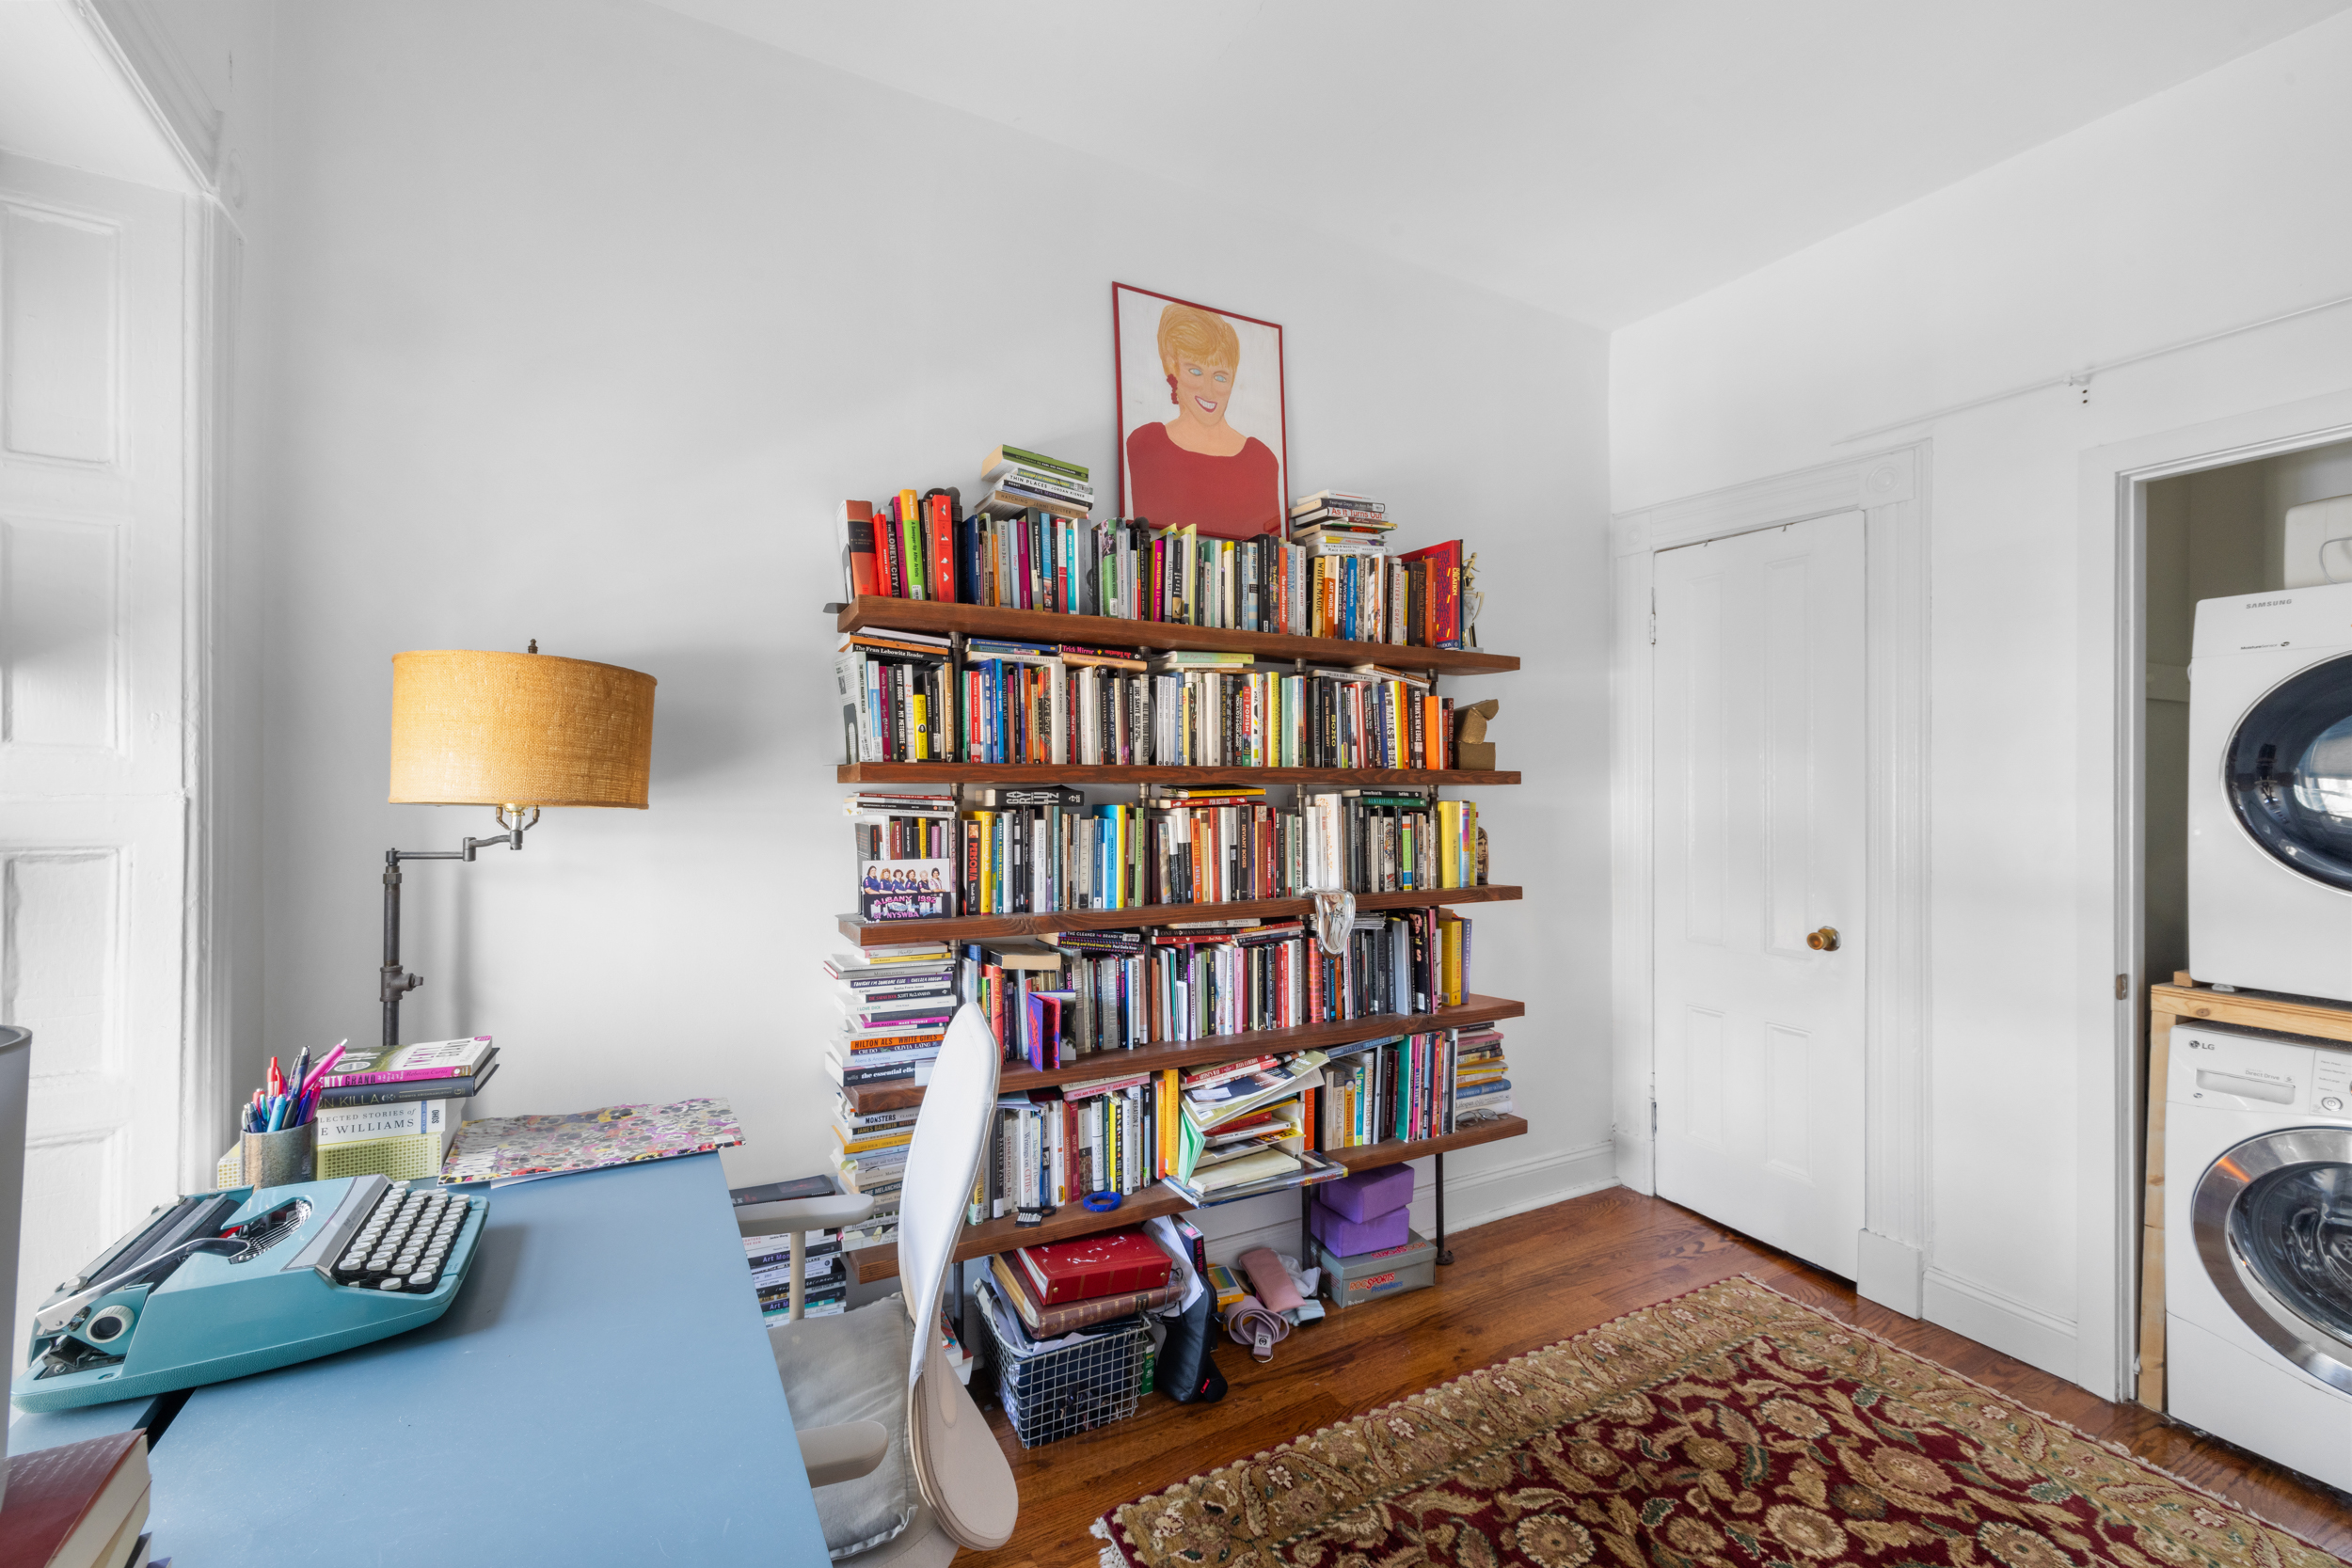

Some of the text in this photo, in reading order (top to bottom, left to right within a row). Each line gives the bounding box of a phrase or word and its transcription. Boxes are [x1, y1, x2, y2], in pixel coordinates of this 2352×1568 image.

[1026, 479, 1047, 488] PLACES
[1001, 494, 1028, 504] HATCHING
[1051, 505, 1071, 514] QUILTER
[888, 534, 897, 564] LONELY
[2246, 599, 2292, 609] SAMSUNG
[1449, 701, 1453, 710] ON
[969, 843, 977, 881] PERSON/A
[875, 896, 912, 906] ALBANY
[319, 1074, 375, 1088] ENTY GRAND
[340, 1094, 379, 1107] KILLA
[320, 1114, 358, 1123] LECTED
[363, 1110, 404, 1119] STORIES
[866, 1115, 896, 1124] MONSTERS
[336, 1120, 414, 1134] WILLIAMS
[875, 1183, 902, 1194] MELANCHOL
[1007, 1187, 1011, 1197] Rx
